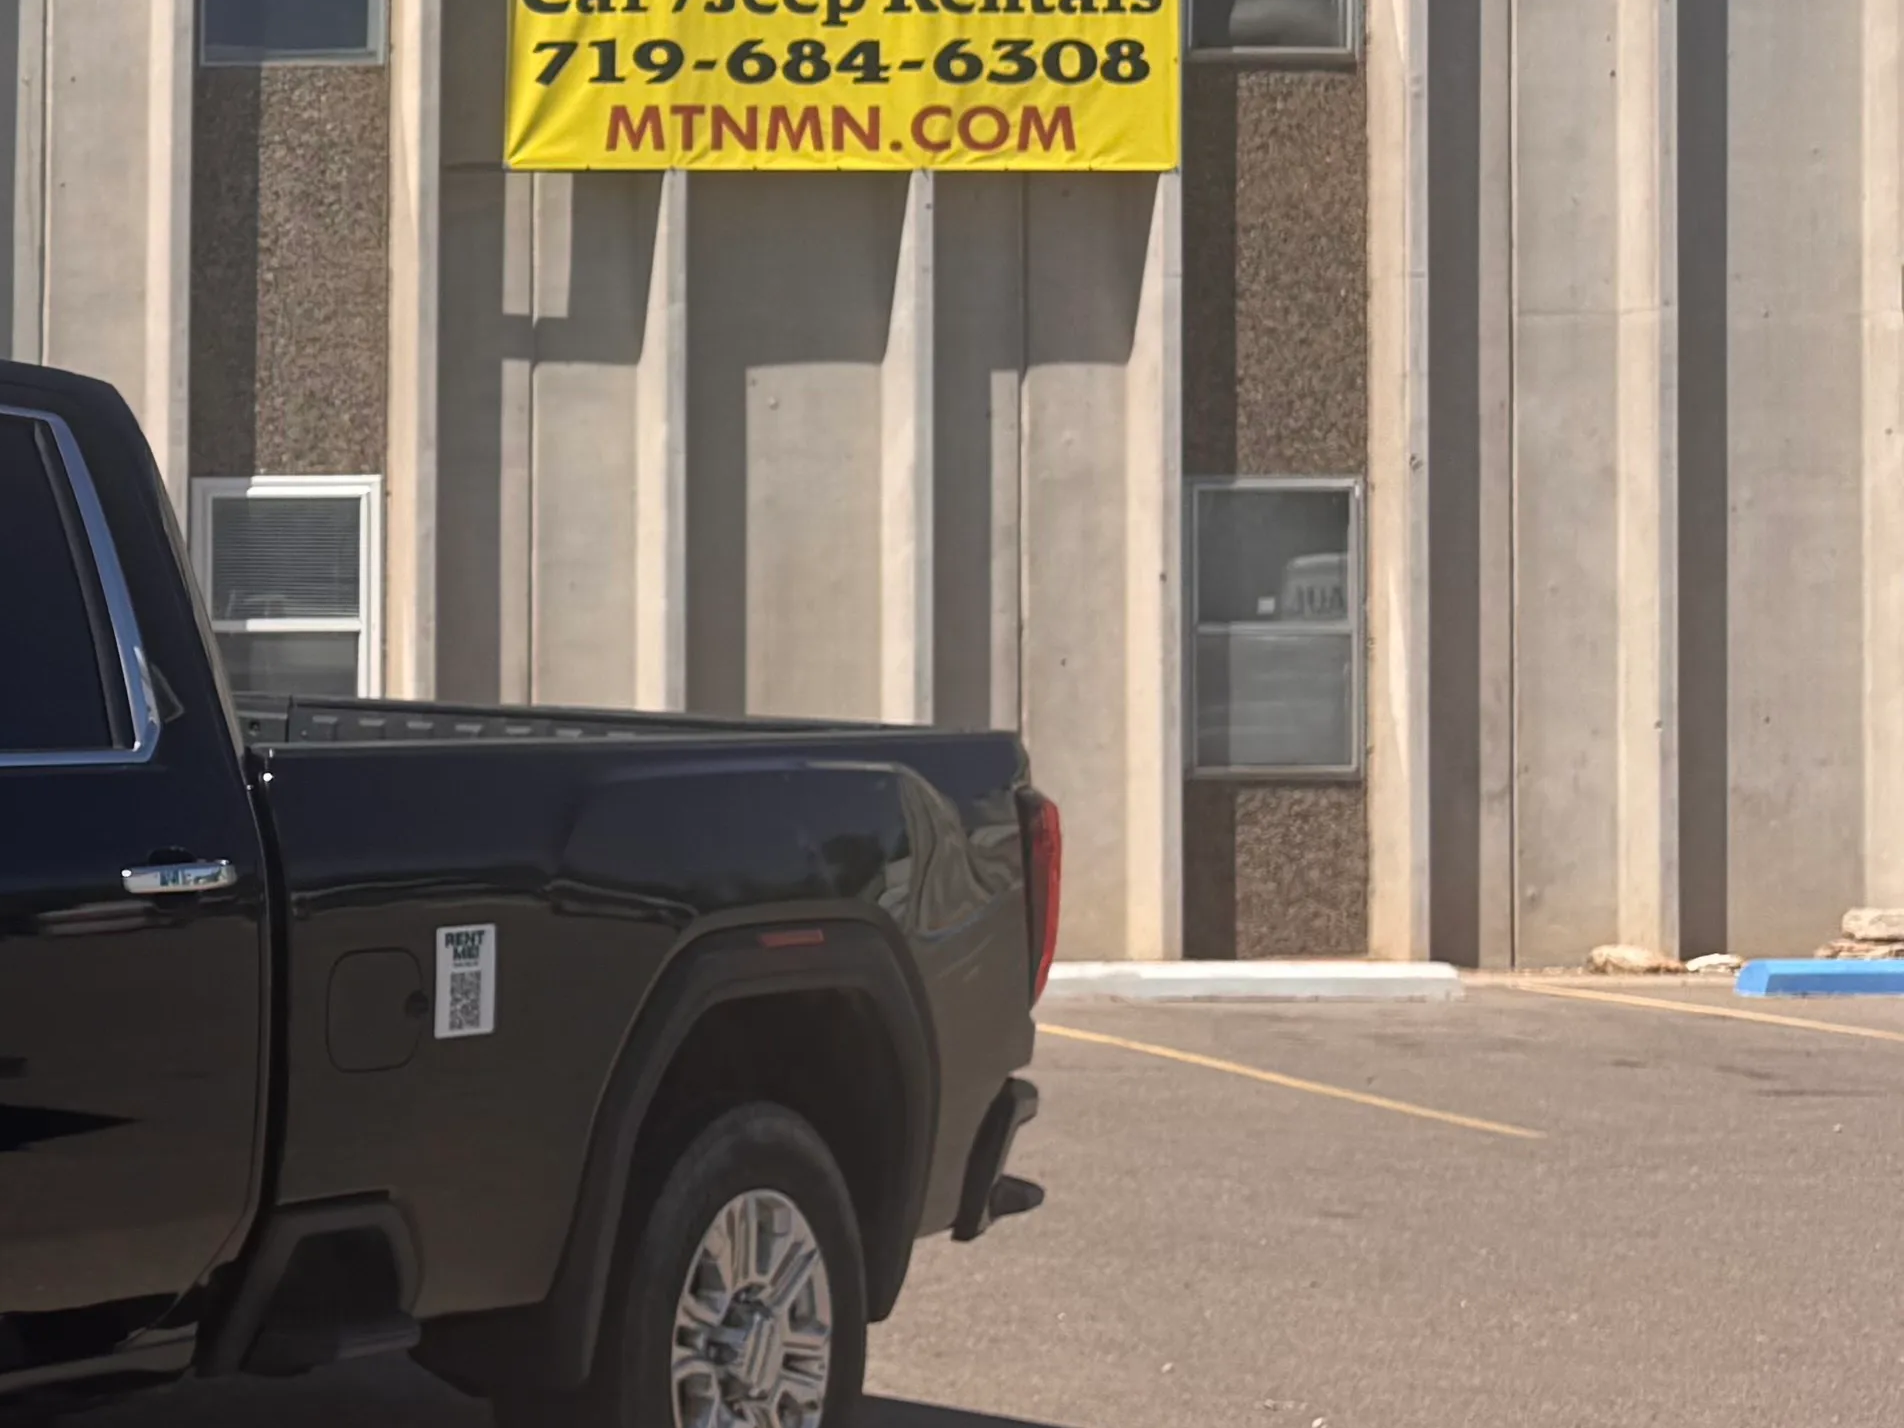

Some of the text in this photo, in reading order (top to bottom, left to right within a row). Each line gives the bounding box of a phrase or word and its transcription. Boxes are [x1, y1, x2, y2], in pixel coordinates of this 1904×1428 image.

[532, 39, 1151, 86] 719-684-6308
[604, 104, 1077, 153] MTNMN.COM
[445, 929, 485, 949] RENT
